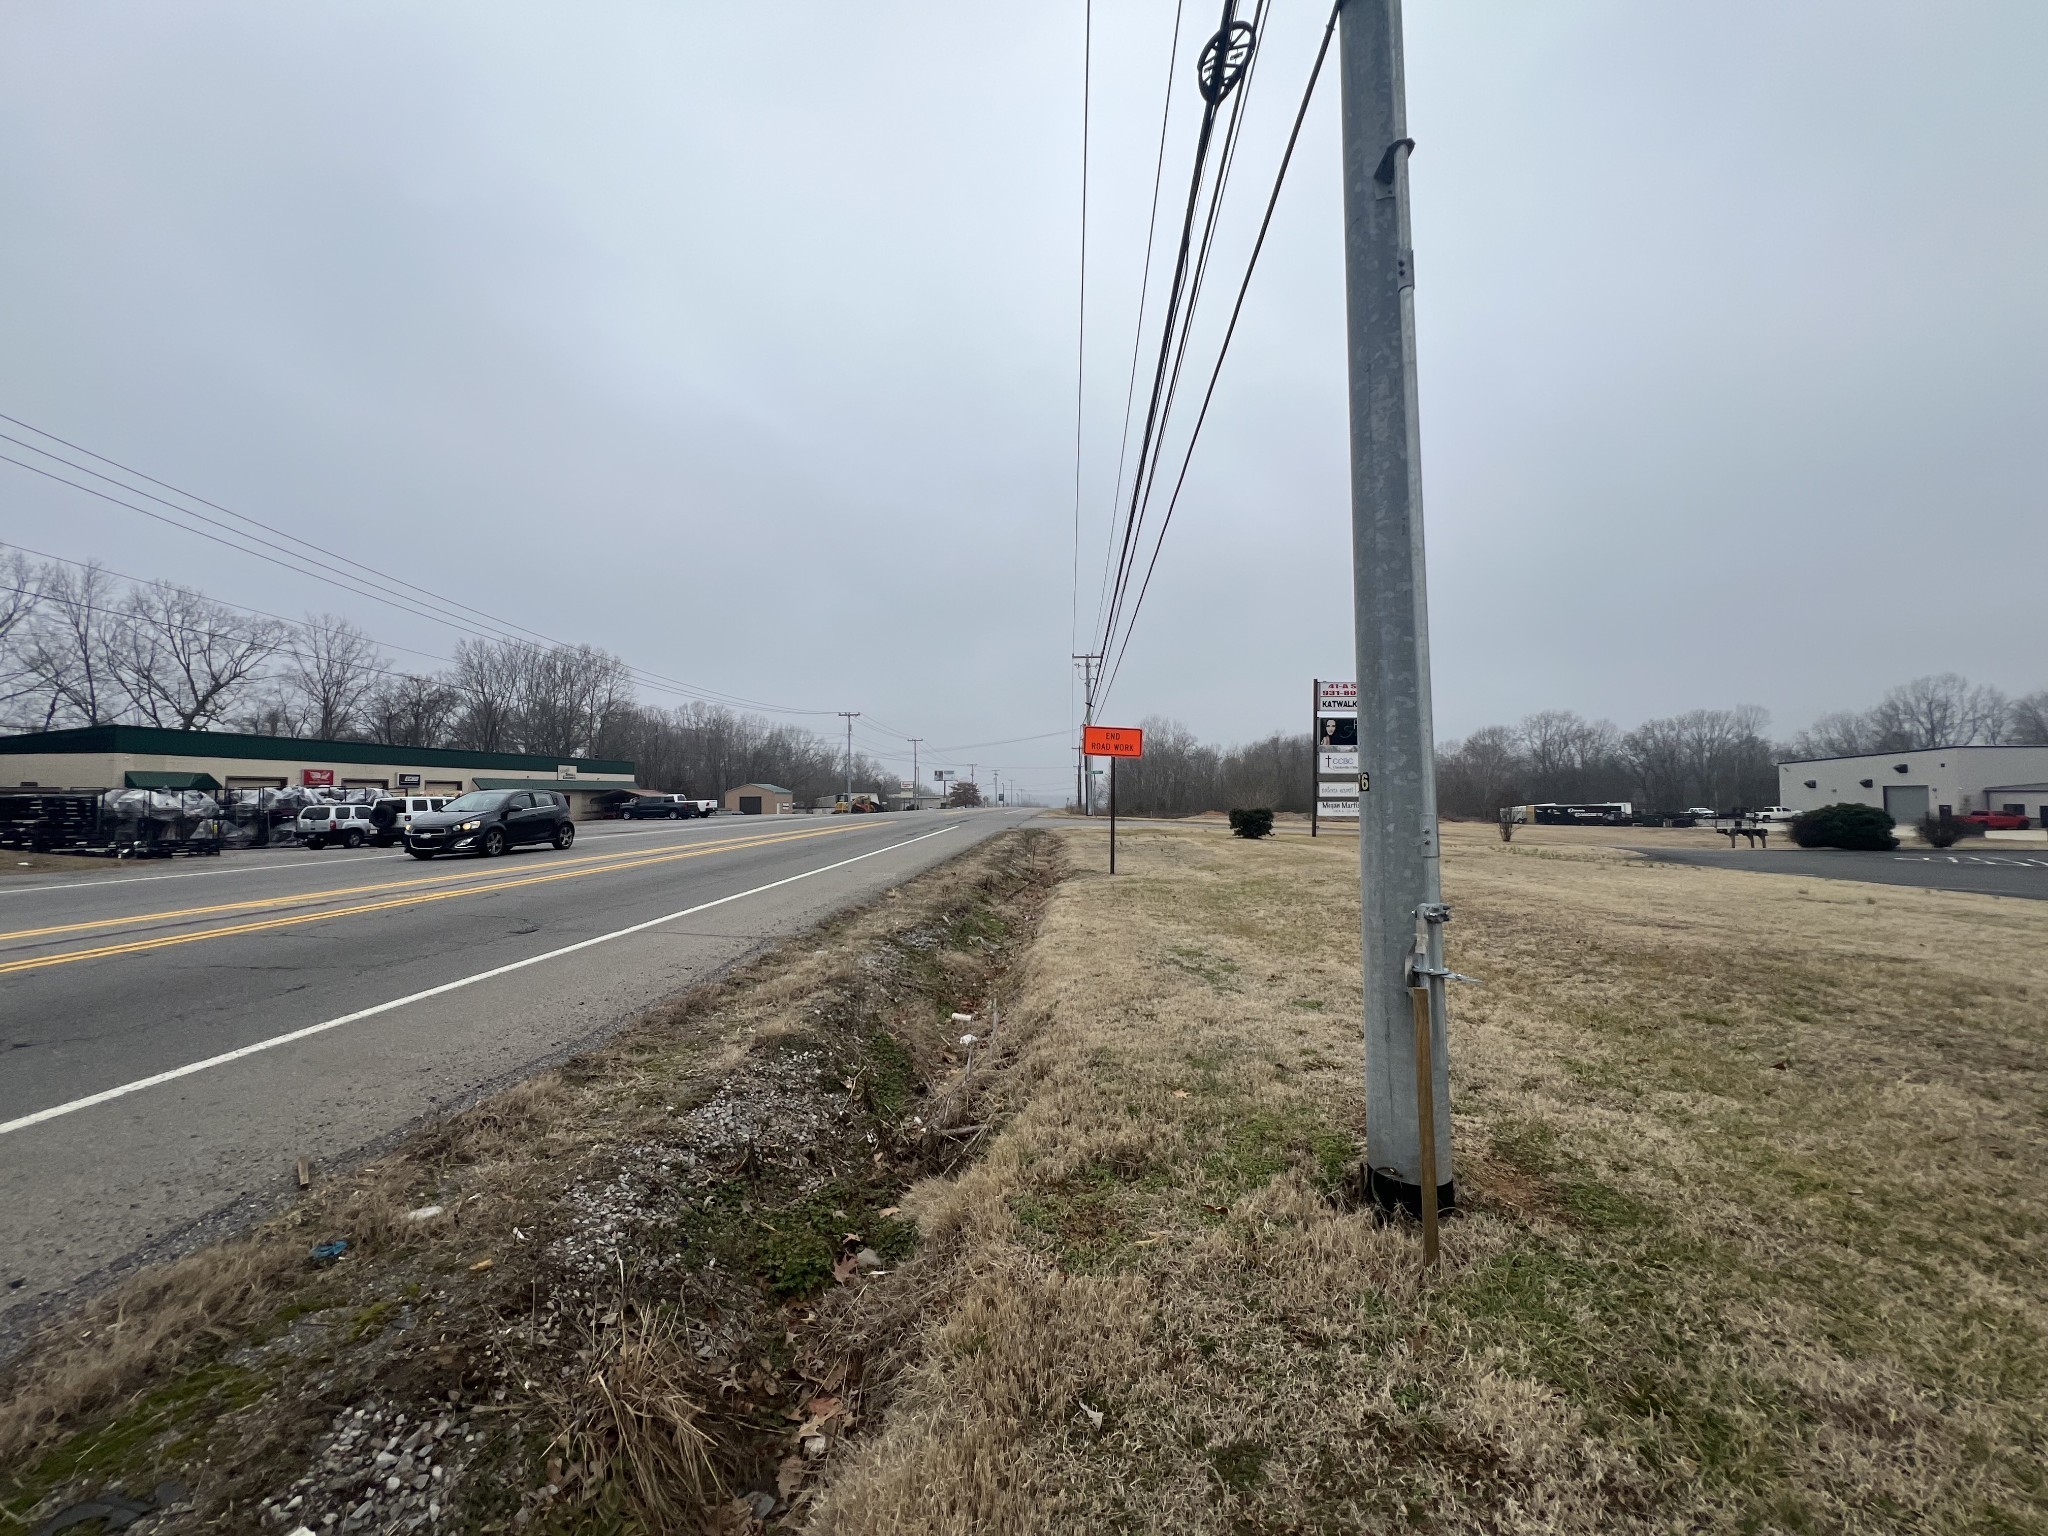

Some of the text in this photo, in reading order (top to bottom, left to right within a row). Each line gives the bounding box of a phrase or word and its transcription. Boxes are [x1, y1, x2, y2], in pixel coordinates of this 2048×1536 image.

[1105, 732, 1121, 740] END
[1091, 742, 1134, 752] ROAD WORK
[1361, 773, 1369, 791] 6
